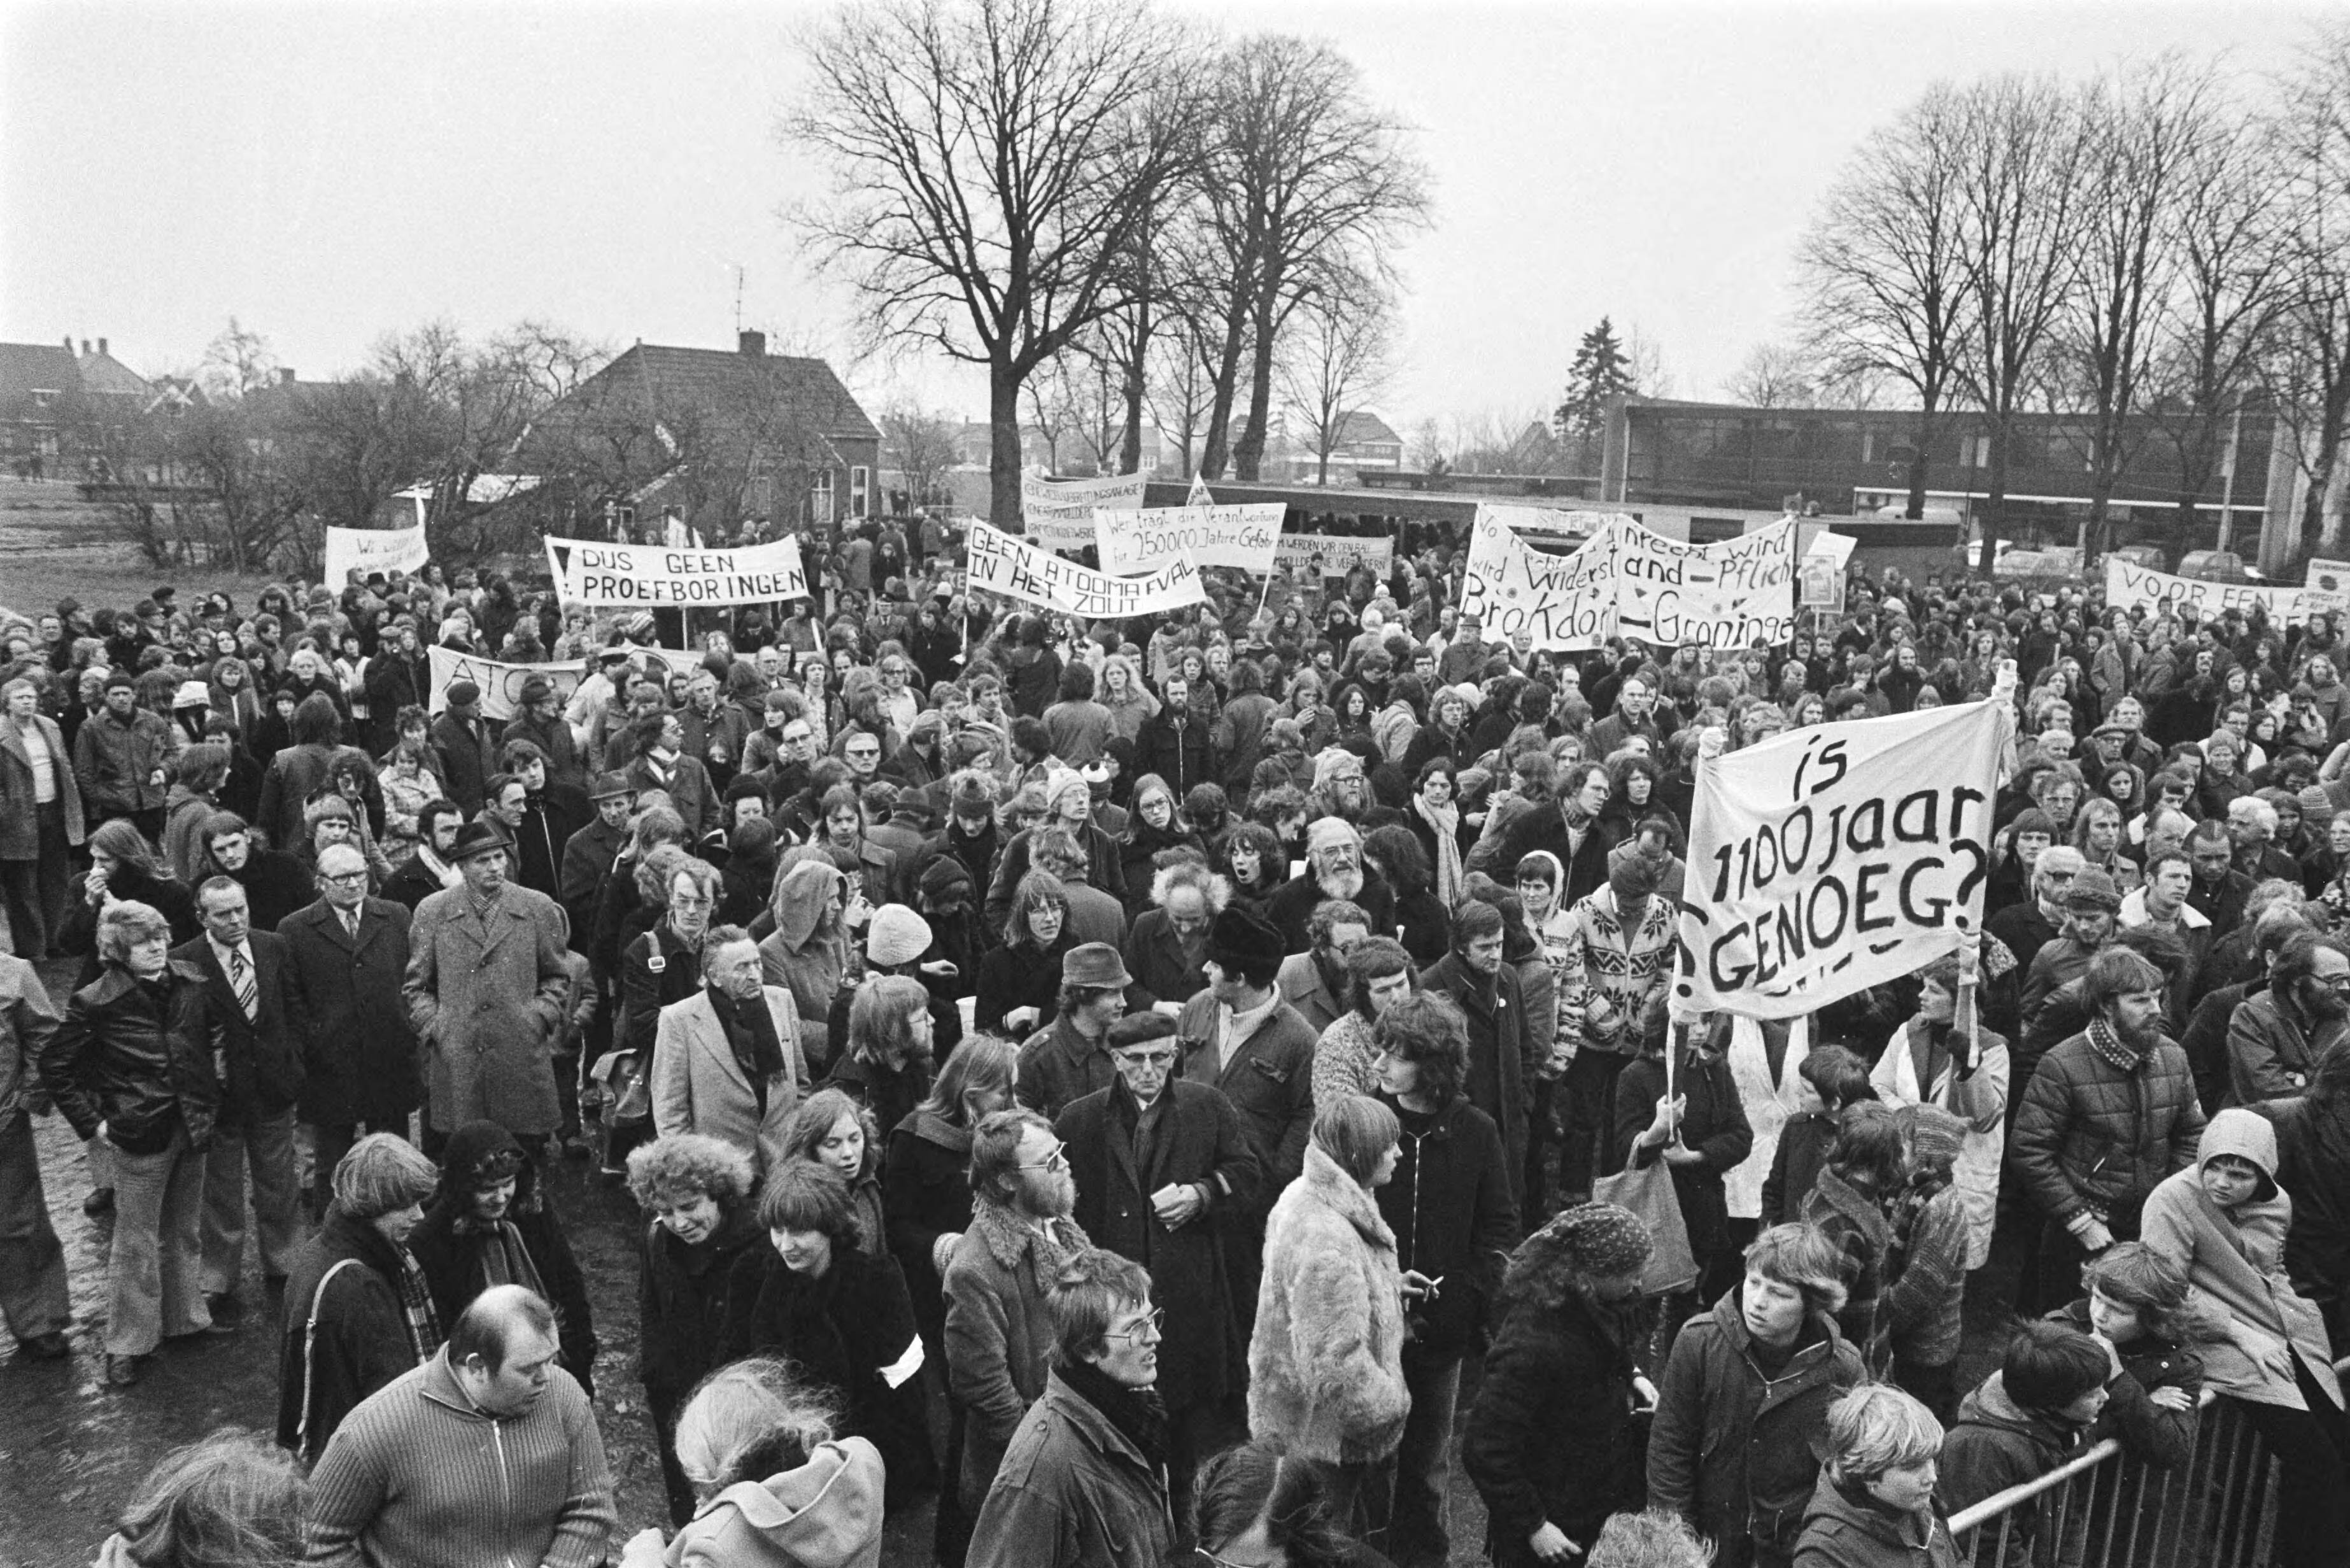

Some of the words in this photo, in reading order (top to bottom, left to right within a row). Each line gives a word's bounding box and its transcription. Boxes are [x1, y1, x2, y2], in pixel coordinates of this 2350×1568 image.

[1105, 512, 1131, 535] Wer
[1136, 509, 1170, 529] trägt
[1198, 527, 1236, 547] Jahre
[1728, 521, 1792, 560] wird
[583, 549, 634, 571] DUS
[666, 553, 735, 574] GEEN
[972, 526, 1031, 569] GEEN
[583, 568, 805, 601] PROEFBORINGEN
[970, 553, 998, 581] IN
[1010, 566, 1056, 599] HET
[1073, 591, 1140, 614] ZOUT
[2123, 566, 2207, 605] VOOR
[2221, 588, 2274, 612] EEN
[1792, 733, 1848, 802] is
[1711, 805, 1814, 903] 1100
